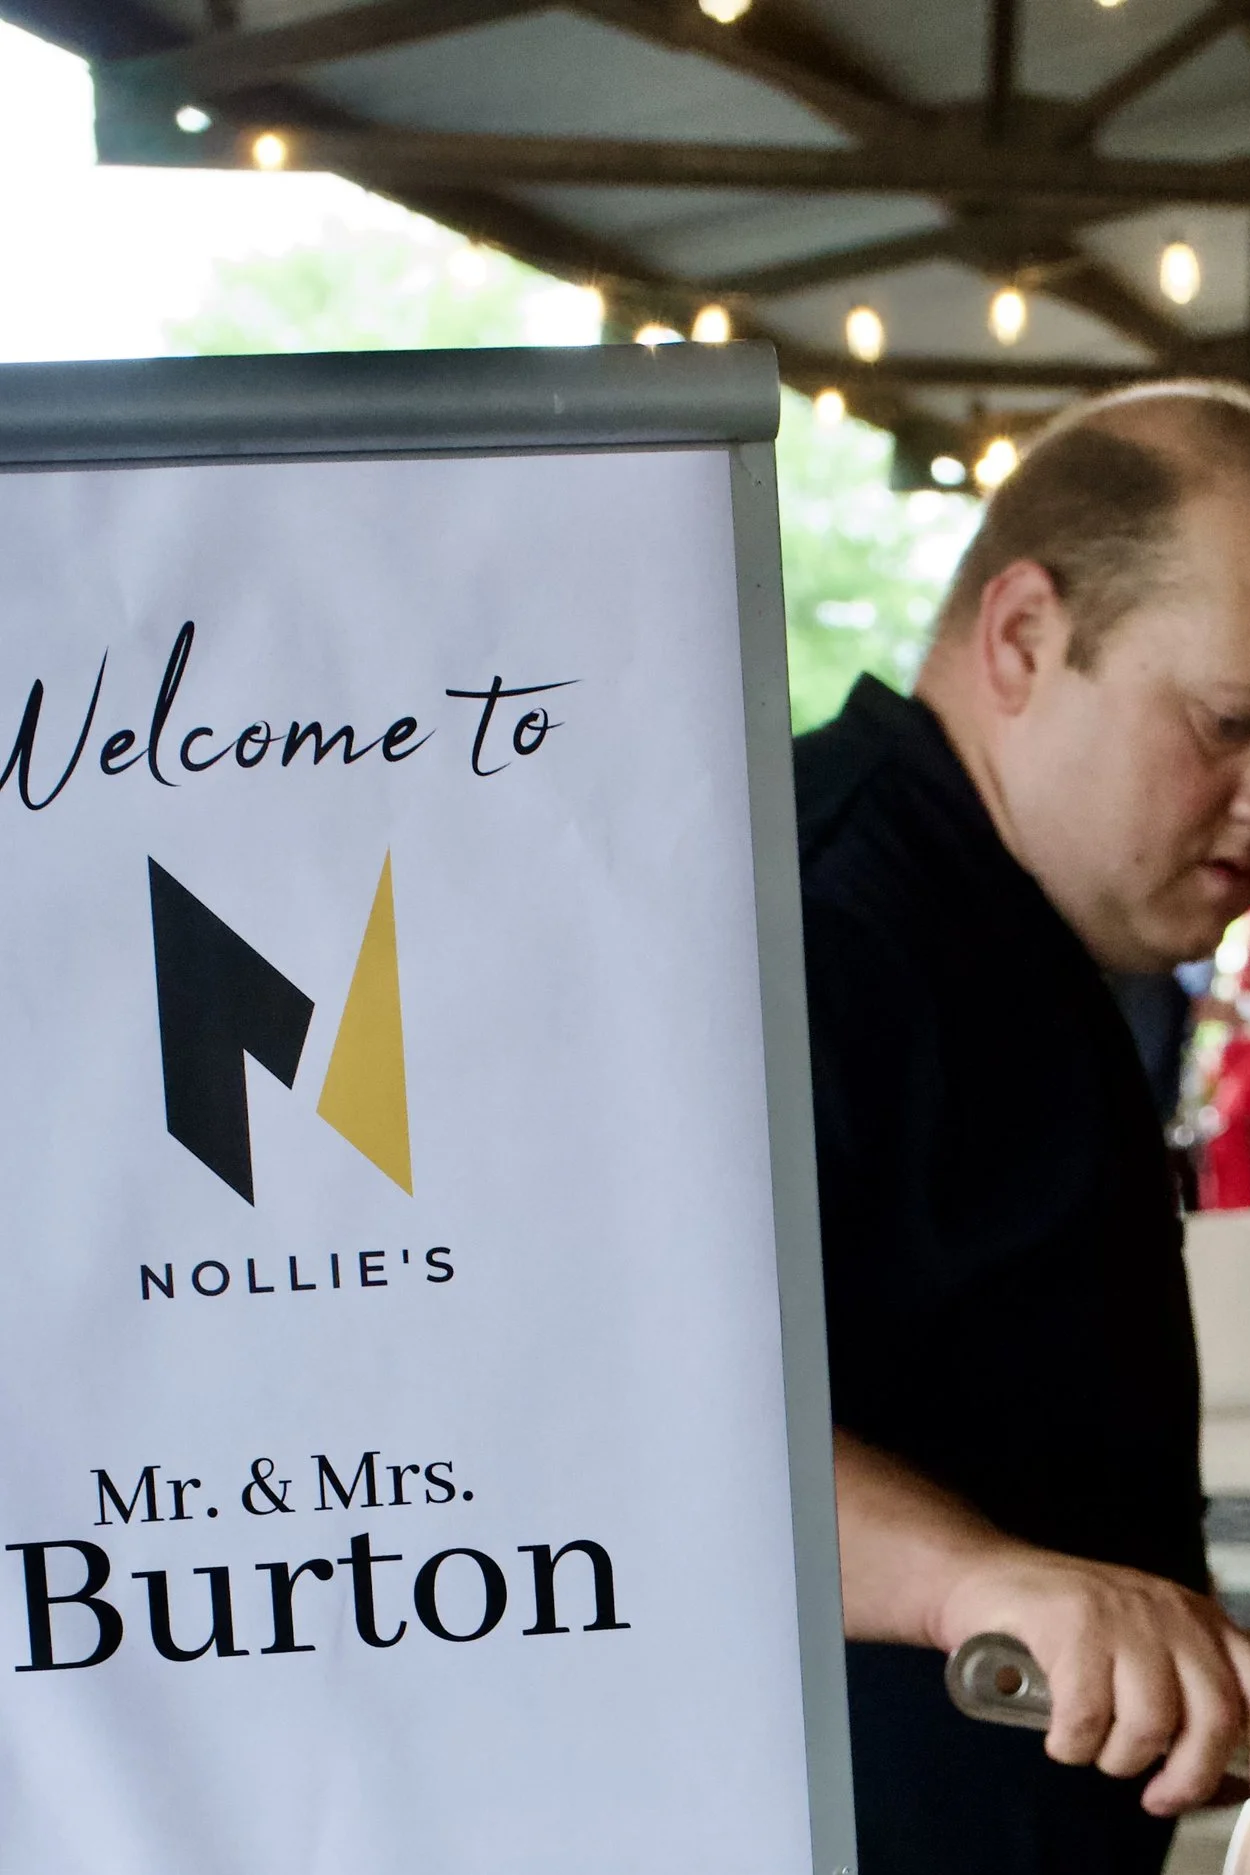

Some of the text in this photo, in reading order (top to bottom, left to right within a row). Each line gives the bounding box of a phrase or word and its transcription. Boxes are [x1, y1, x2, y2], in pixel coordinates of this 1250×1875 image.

[444, 674, 583, 778] to
[139, 1245, 456, 1302] NOLLIE'S
[89, 1450, 475, 1527] Mr. & Mrs.
[4, 1531, 633, 1674] Burton
